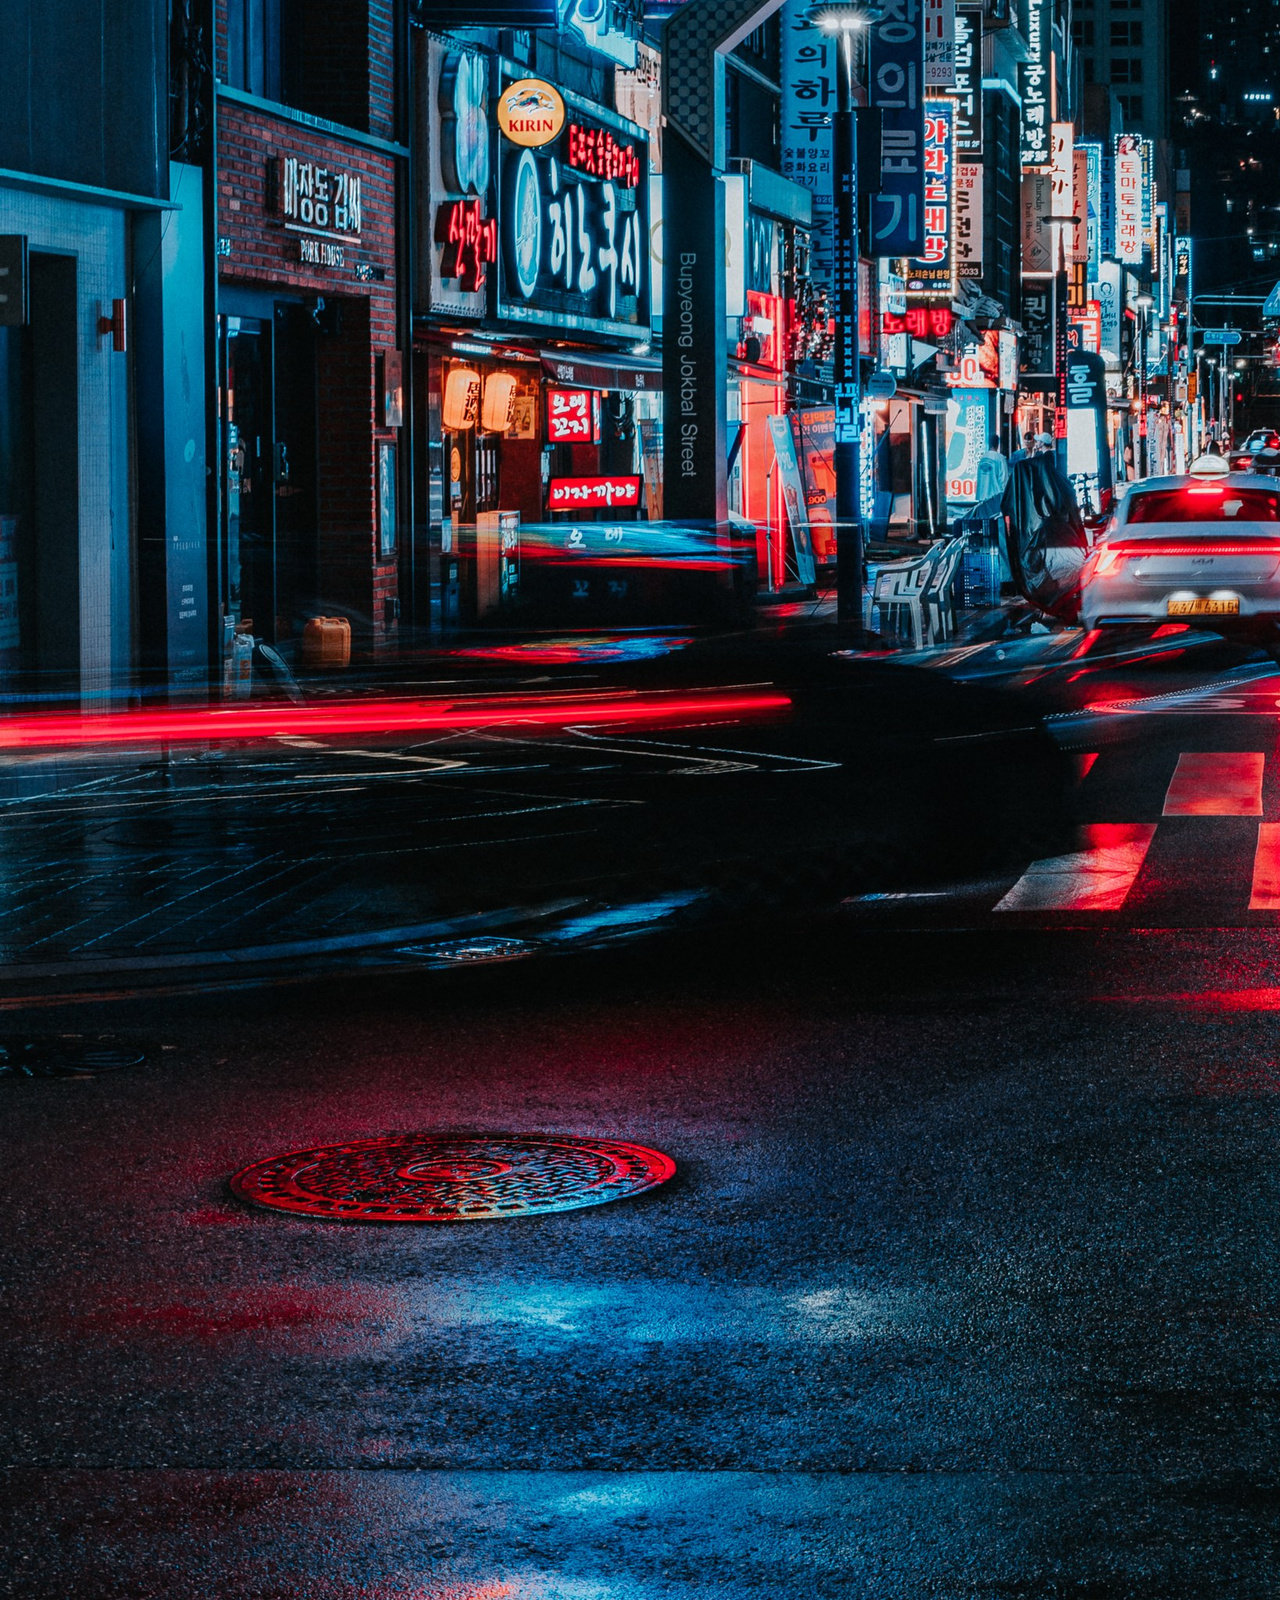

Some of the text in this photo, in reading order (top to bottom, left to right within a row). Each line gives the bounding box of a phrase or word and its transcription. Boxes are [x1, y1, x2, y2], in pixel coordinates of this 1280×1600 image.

[1024, 65, 1047, 151] 궁노래방
[508, 118, 553, 132] KIRIN
[1035, 177, 1045, 210] Thursday
[1120, 161, 1136, 254] 토마토노래방
[300, 238, 345, 268] PORK HOUSE
[883, 308, 952, 336] 노래방
[679, 251, 698, 478] Bupyeong Jokbal Street
[551, 417, 589, 438] 꼬지
[553, 481, 637, 506] 이자까야
